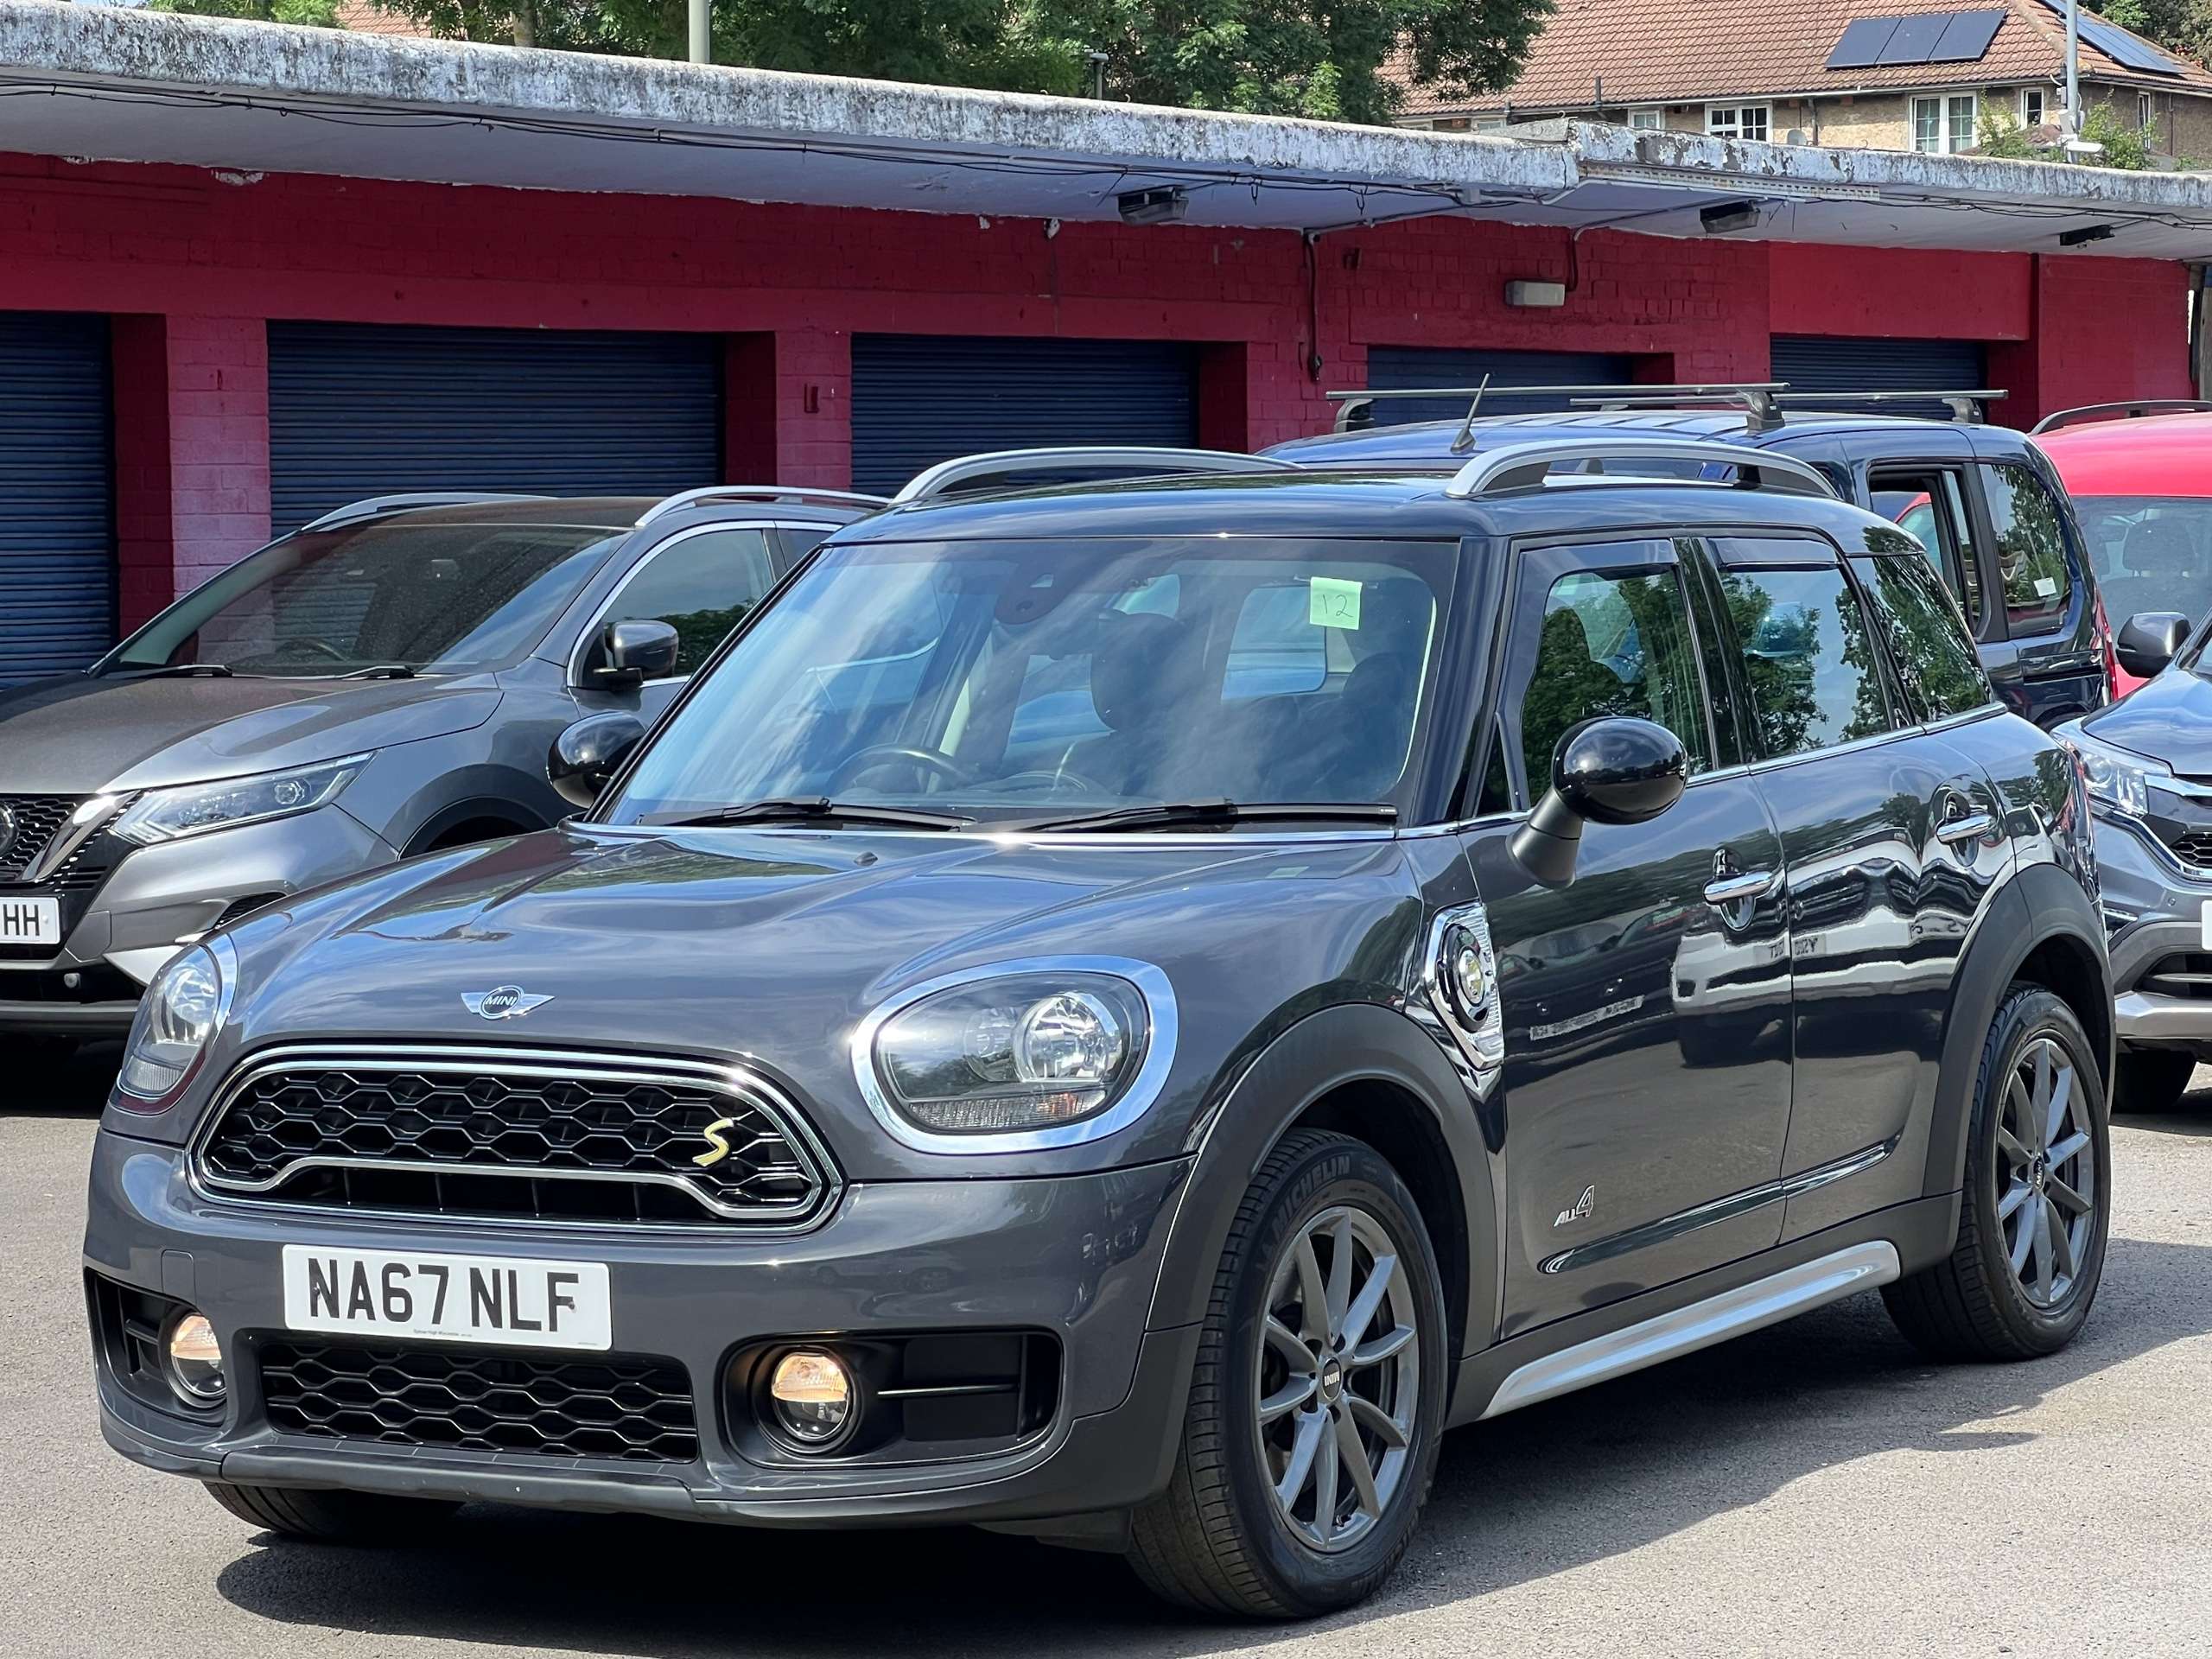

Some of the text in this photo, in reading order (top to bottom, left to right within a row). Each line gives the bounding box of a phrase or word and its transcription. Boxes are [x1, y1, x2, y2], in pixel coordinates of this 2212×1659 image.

[1322, 594, 1354, 618] 12
[3, 904, 40, 936] HH
[485, 995, 518, 1007] MINI
[692, 1118, 734, 1167] S
[1271, 1155, 1351, 1243] MICHELIN
[308, 1257, 580, 1332] NA67 NLF
